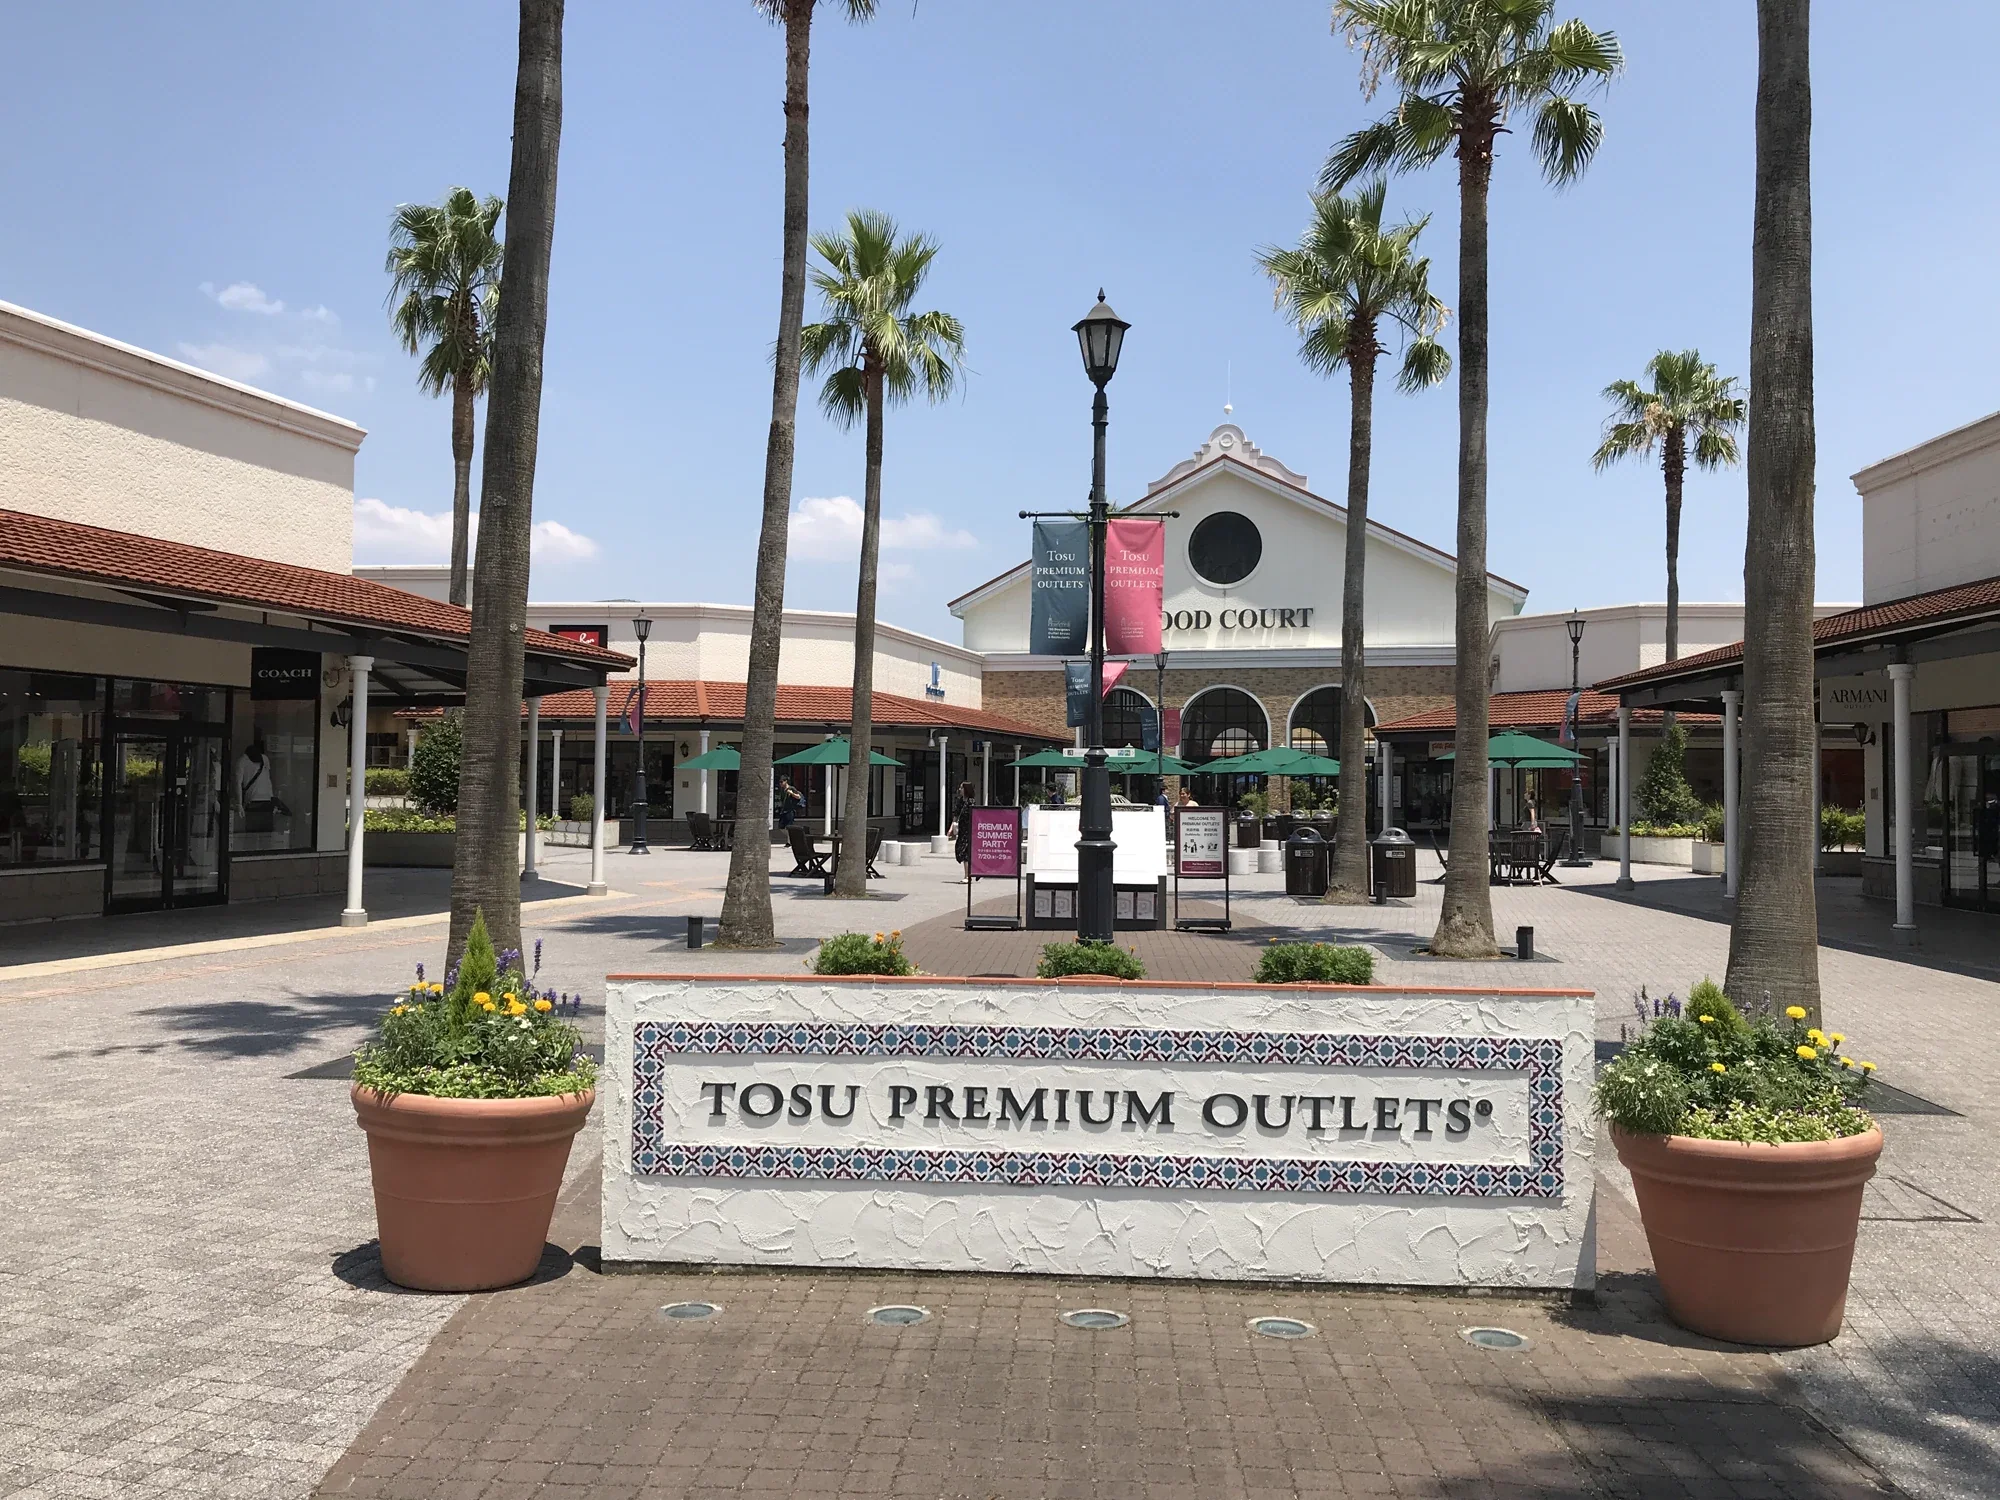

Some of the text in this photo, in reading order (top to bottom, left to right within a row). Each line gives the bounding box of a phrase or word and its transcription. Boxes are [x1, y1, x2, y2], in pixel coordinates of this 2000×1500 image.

[1036, 566, 1085, 575] PREMIUM
[1110, 566, 1159, 575] PREMIUM
[1037, 580, 1084, 589] OUTLETS
[1110, 580, 1157, 589] OUTLETS
[1161, 608, 1314, 630] OOD COURT
[258, 669, 312, 678] COACH
[1829, 689, 1887, 703] ARMANI
[978, 823, 1013, 831] PREMIUM
[977, 831, 1013, 840] SUMMER
[982, 840, 1008, 848] PARTY
[701, 1081, 861, 1119] TOSU
[888, 1084, 1175, 1125] PREMIUM
